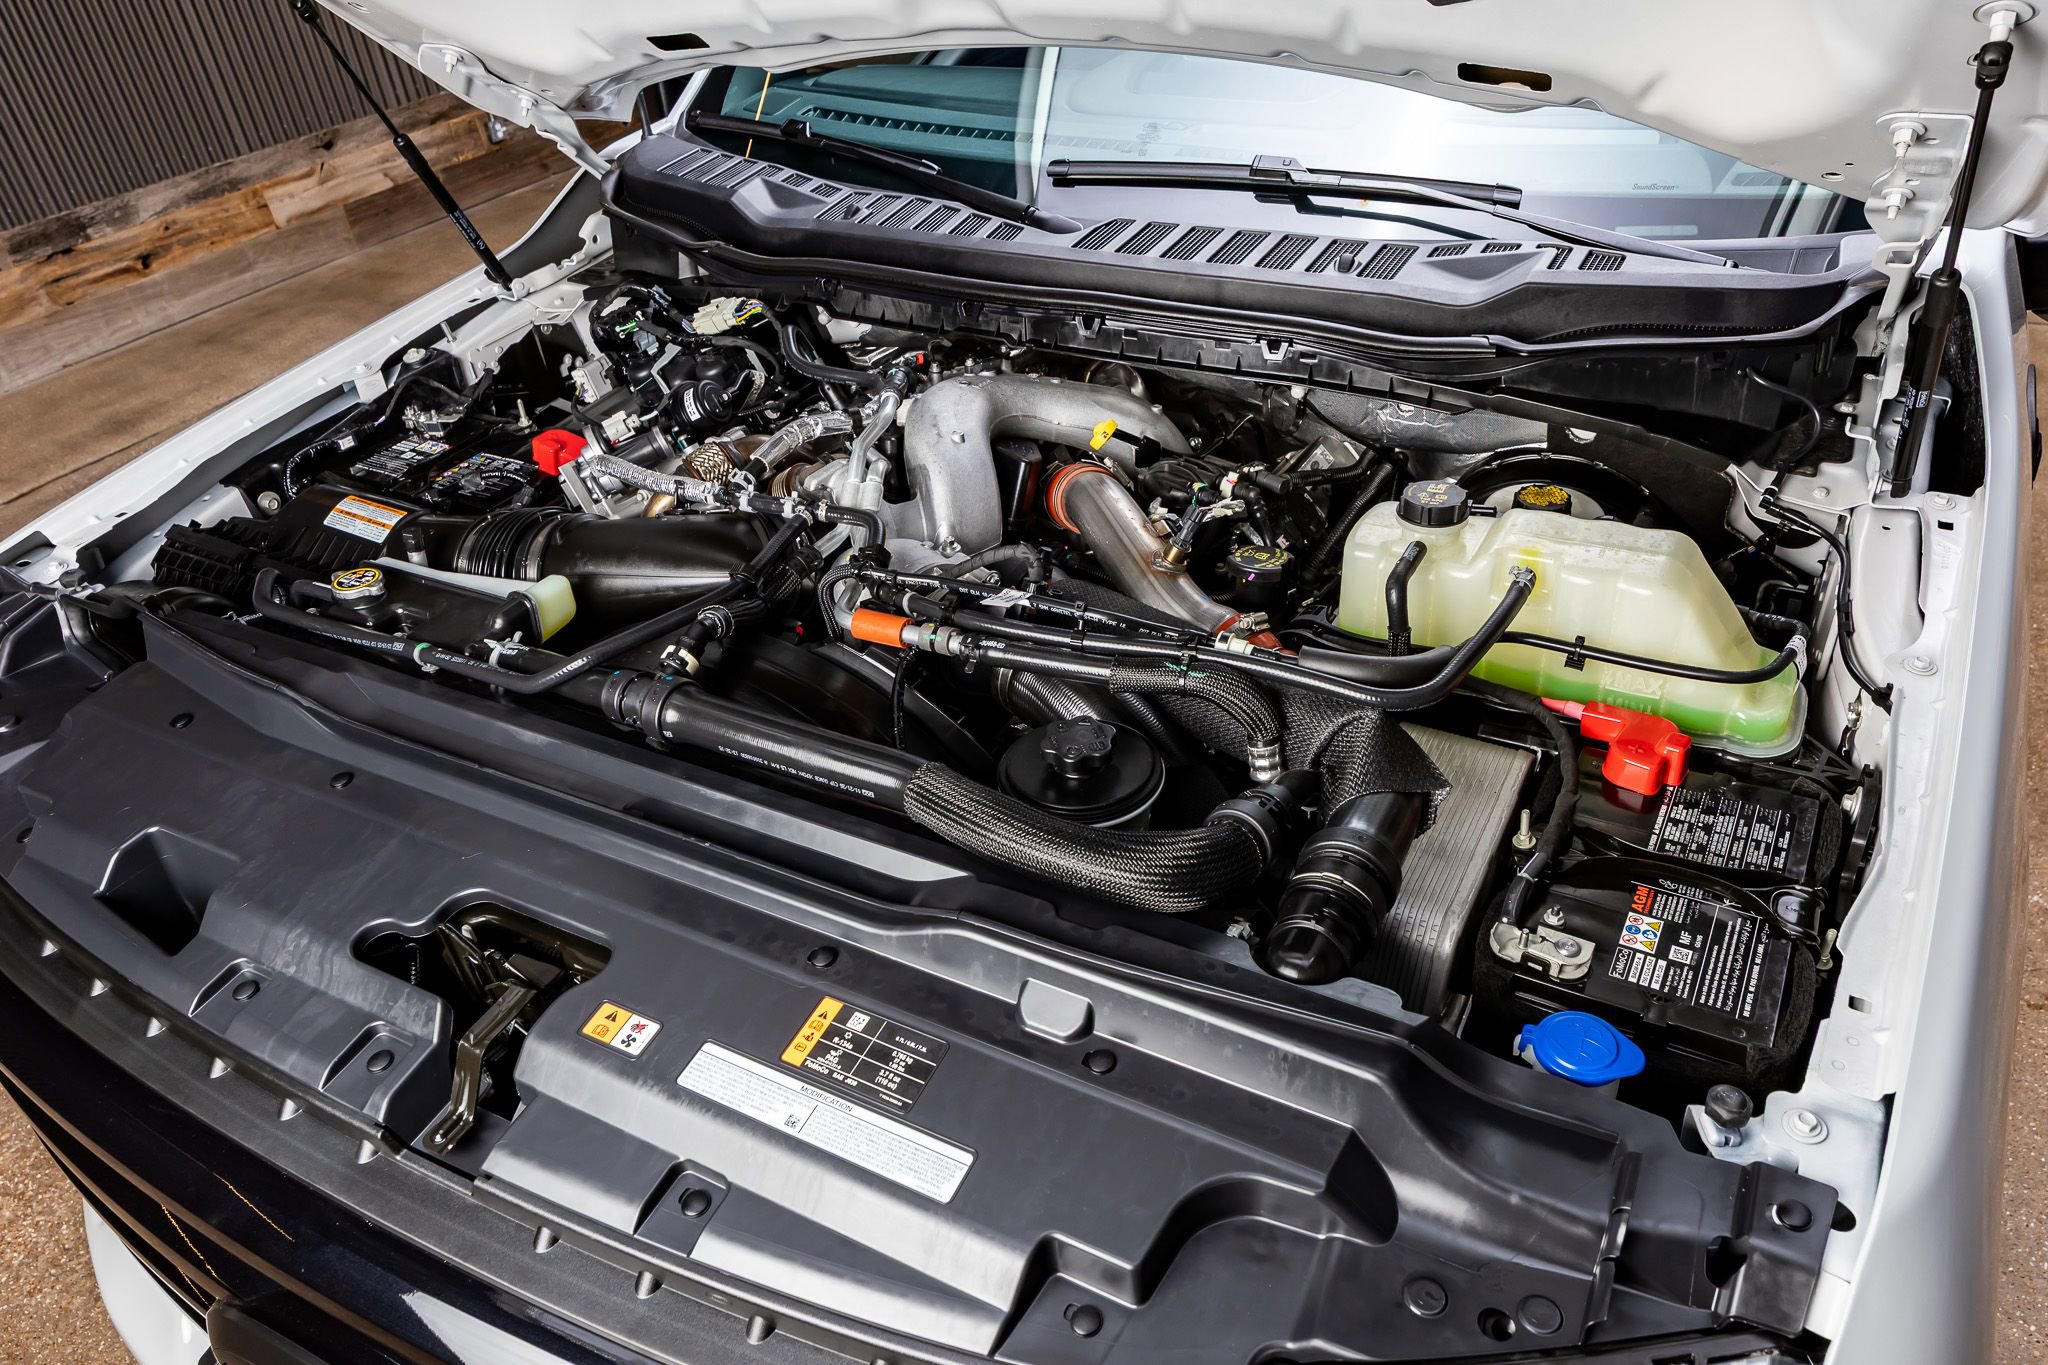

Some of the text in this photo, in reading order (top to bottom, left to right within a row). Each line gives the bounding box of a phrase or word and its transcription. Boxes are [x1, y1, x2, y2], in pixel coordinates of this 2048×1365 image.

[1630, 885, 1649, 912] AGM
[1678, 929, 1692, 945] MF
[1613, 948, 1629, 977] FoMoCo
[831, 1036, 854, 1049] R-134a
[823, 1053, 839, 1063] PAG
[802, 1059, 830, 1074] FoMoCo
[800, 1085, 853, 1112] MODIFICATION
